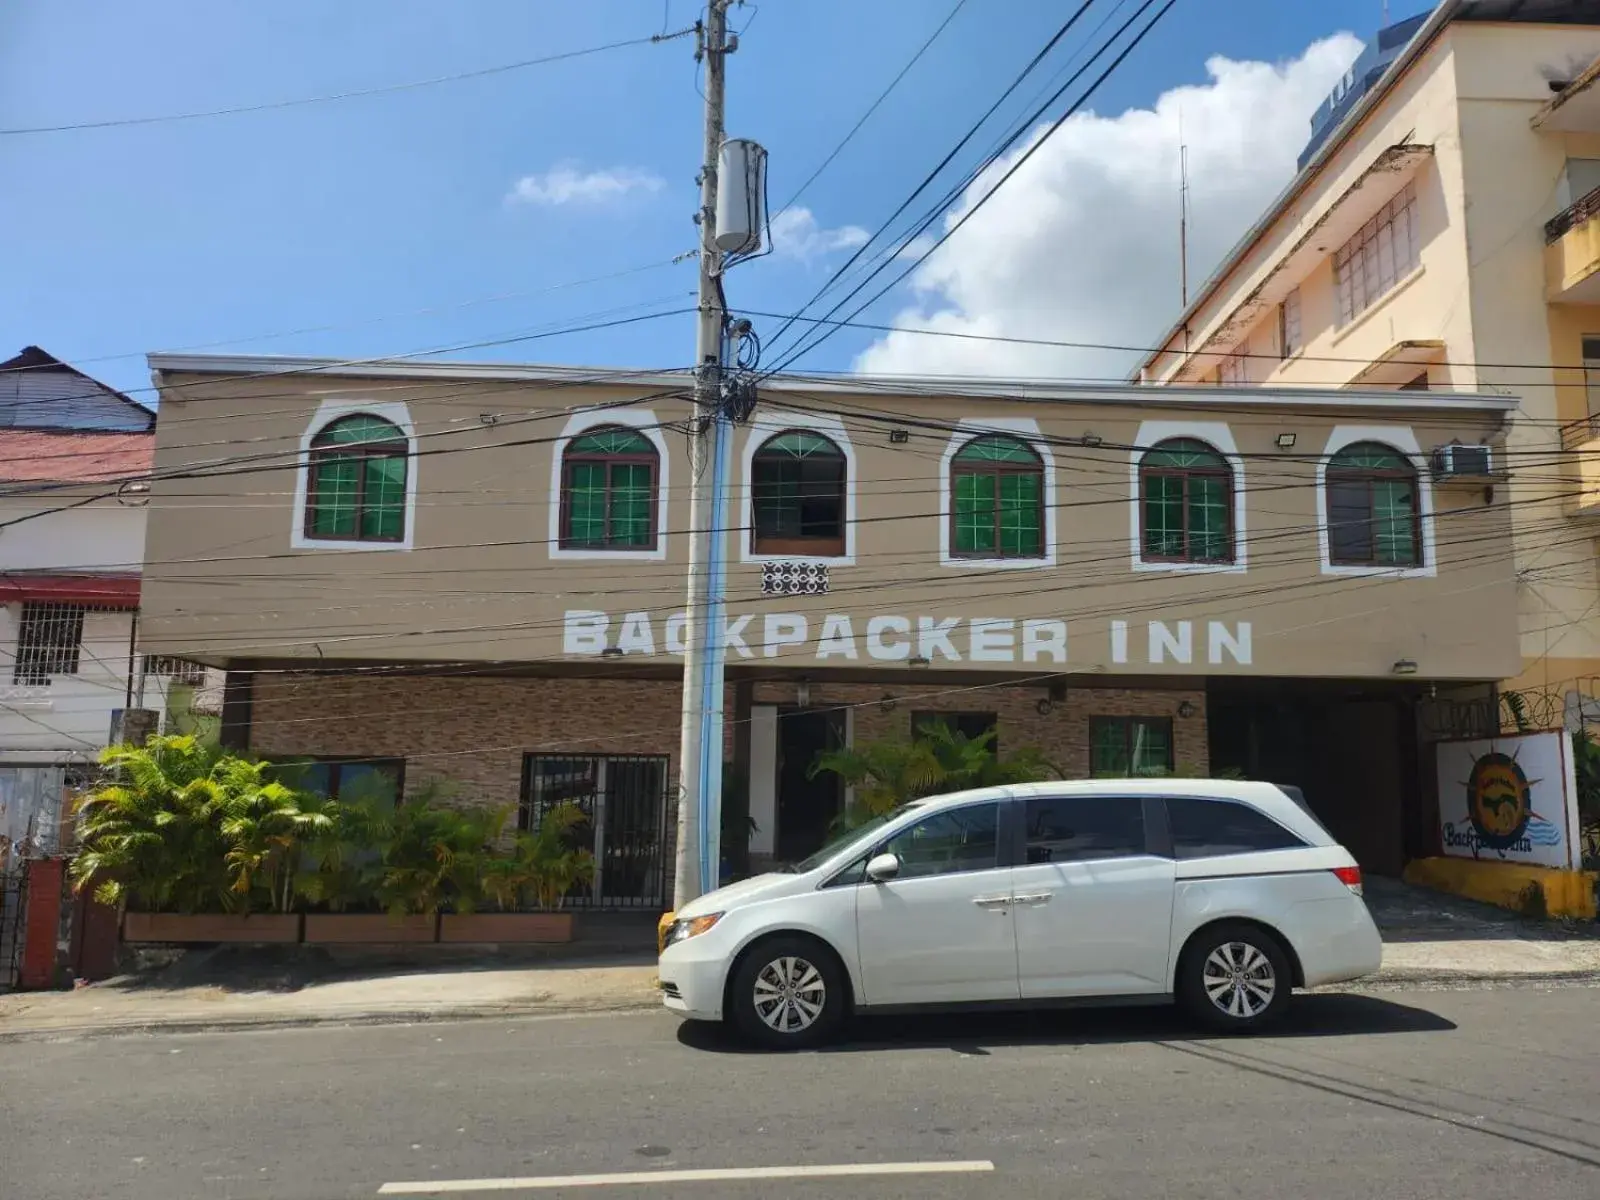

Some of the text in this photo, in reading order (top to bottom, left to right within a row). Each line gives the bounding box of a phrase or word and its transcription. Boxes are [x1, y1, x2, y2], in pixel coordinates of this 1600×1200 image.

[563, 610, 1252, 663] BACKPACKER INN
[1443, 822, 1510, 859] Backp
